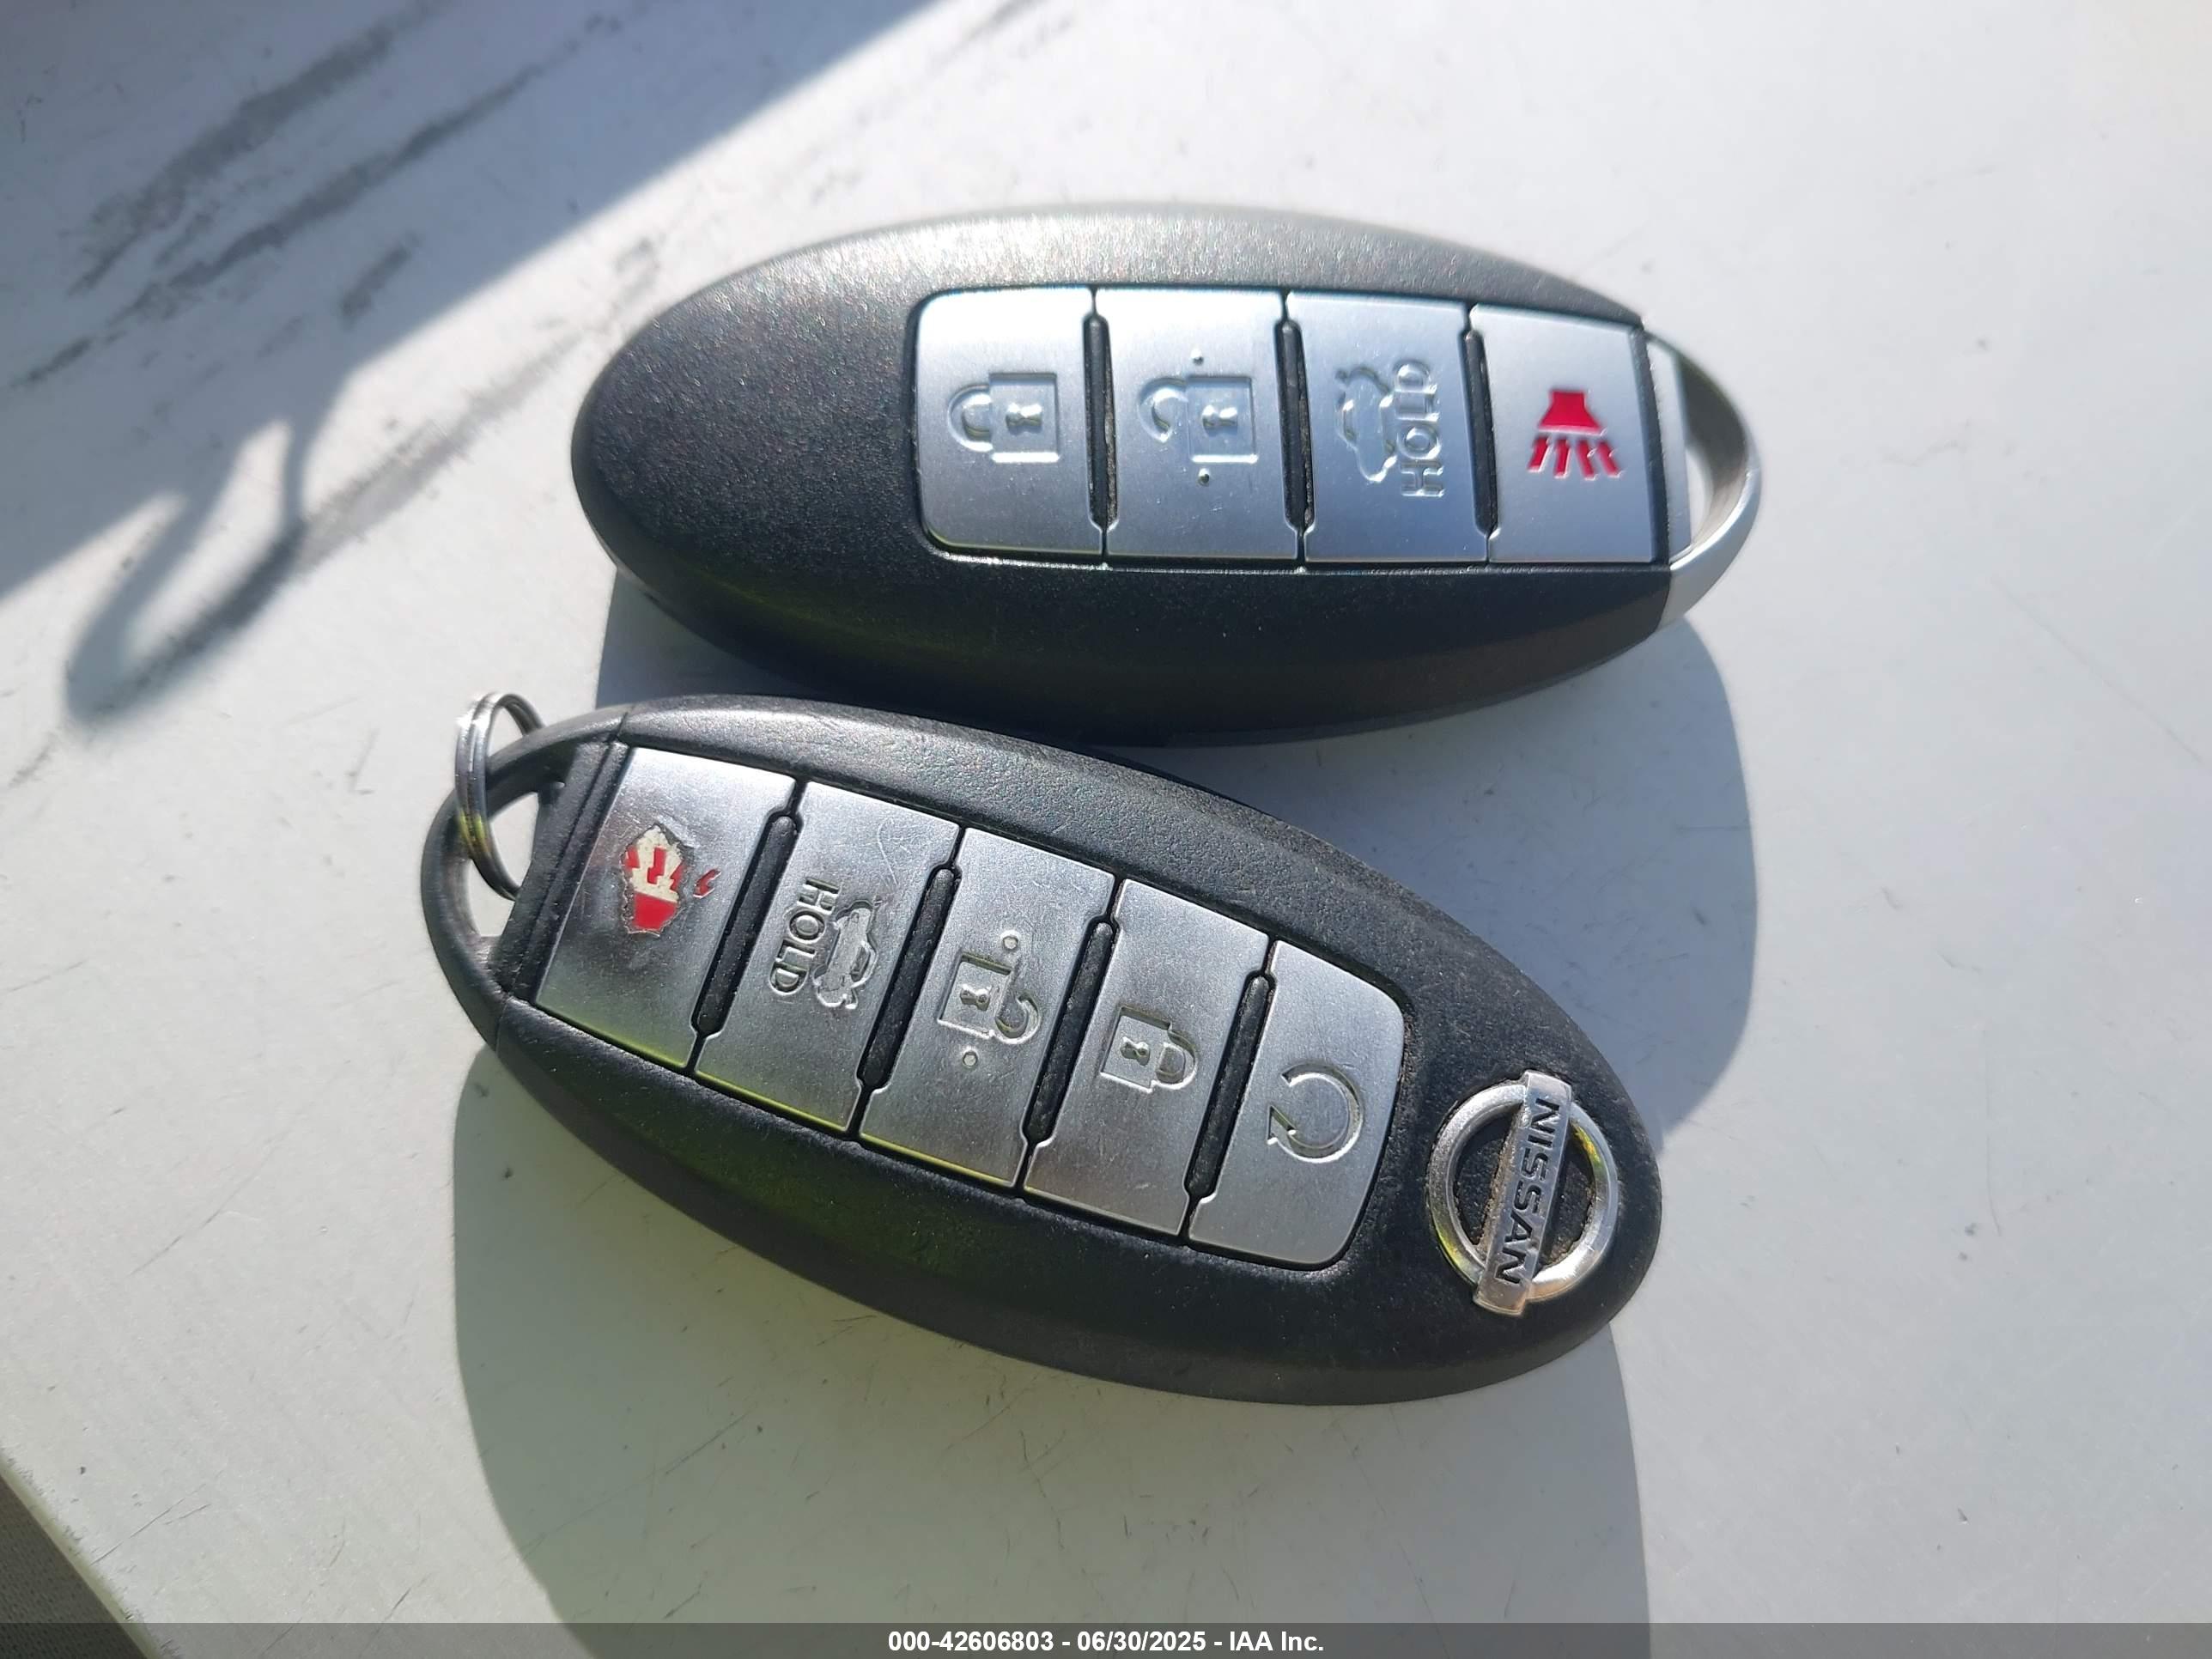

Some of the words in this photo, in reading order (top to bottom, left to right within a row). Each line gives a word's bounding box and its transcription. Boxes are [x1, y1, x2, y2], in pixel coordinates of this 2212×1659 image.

[1393, 359, 1445, 497] HOLD
[769, 877, 842, 996] HOLD
[1493, 1097, 1560, 1285] NISSAN
